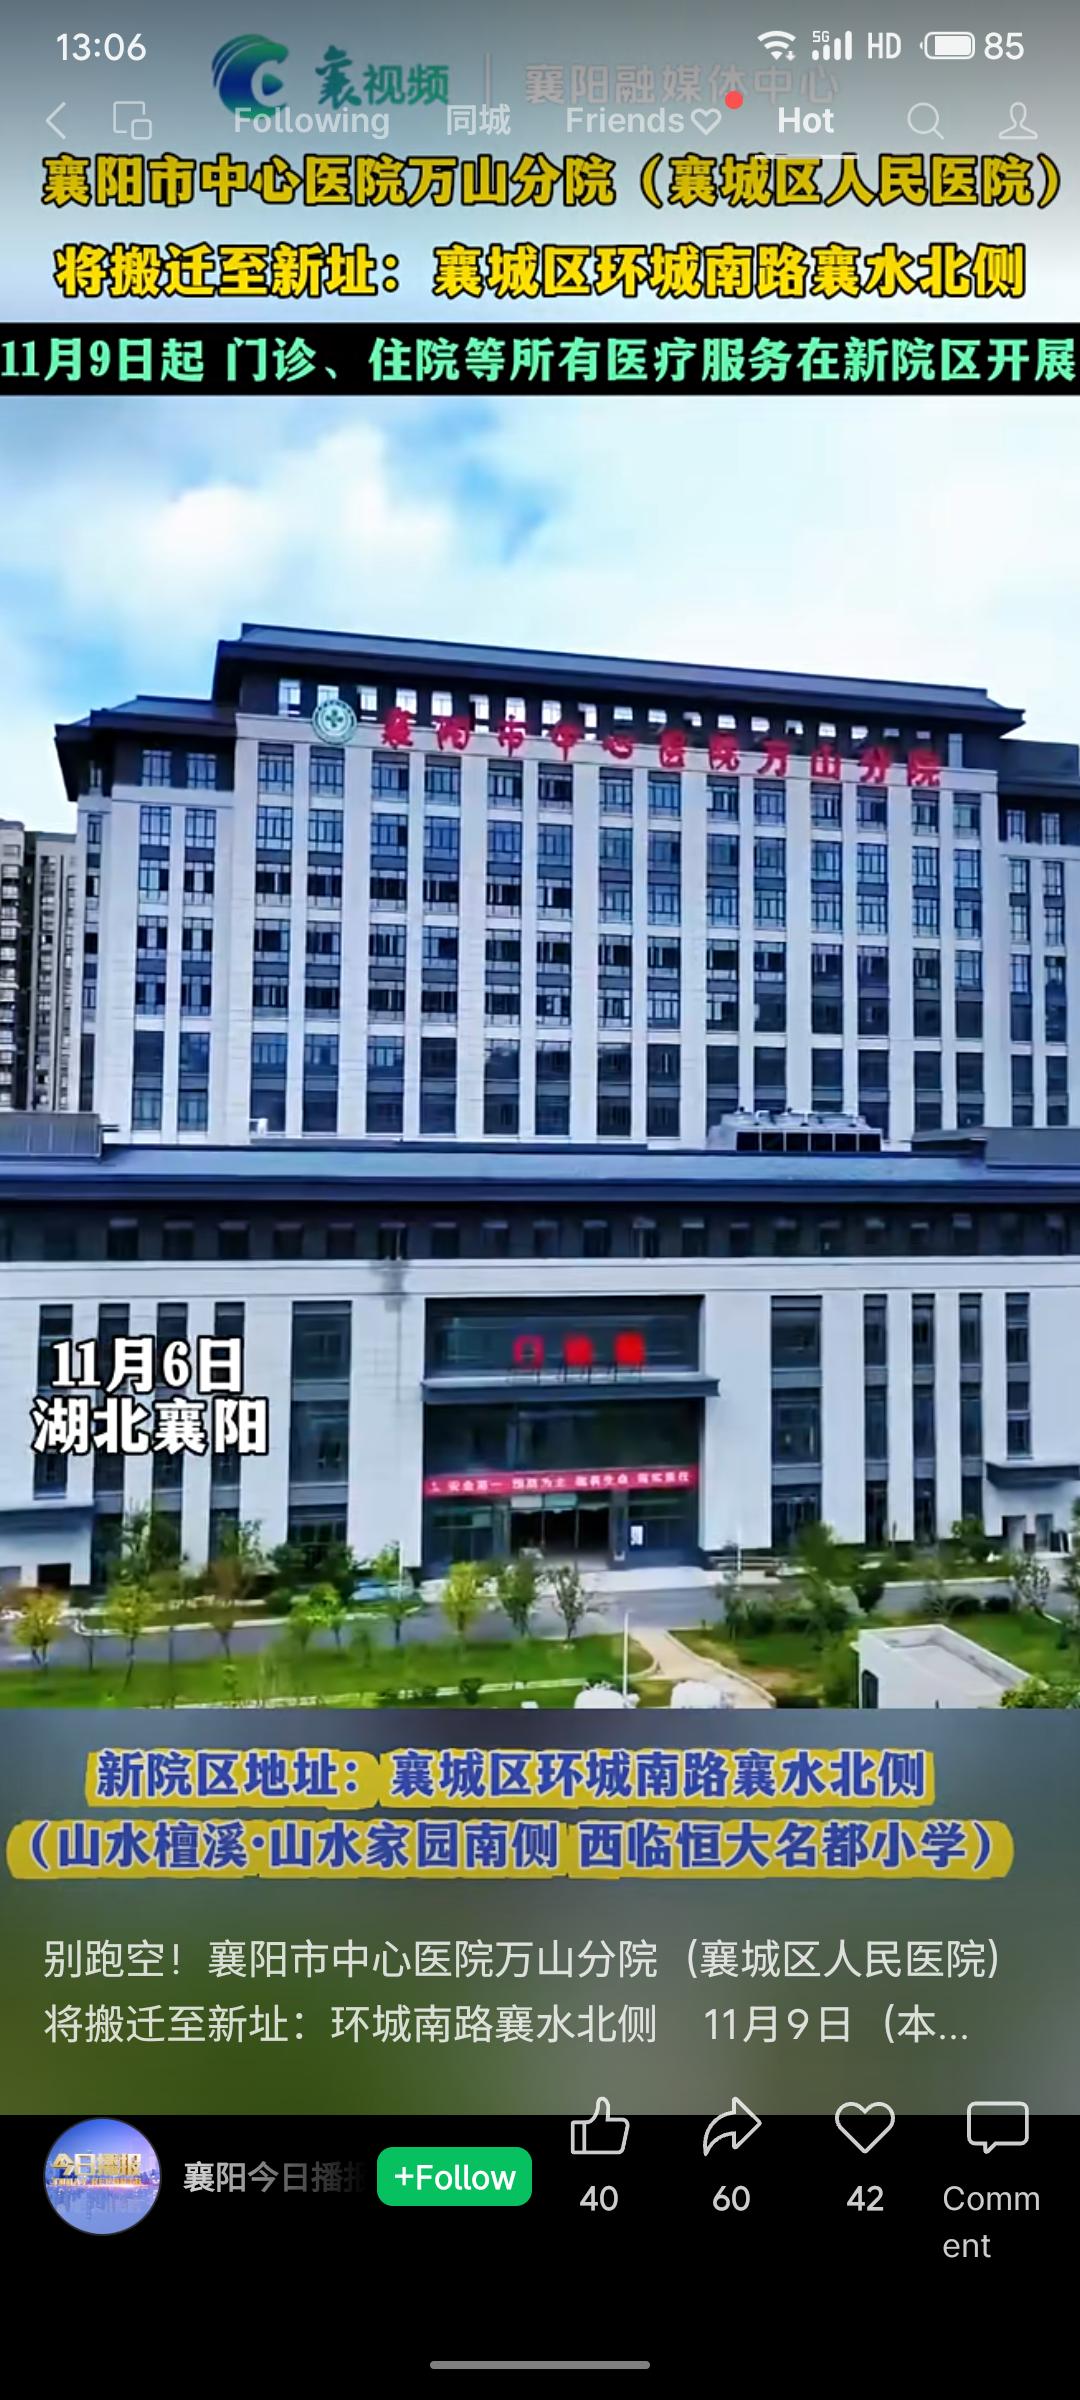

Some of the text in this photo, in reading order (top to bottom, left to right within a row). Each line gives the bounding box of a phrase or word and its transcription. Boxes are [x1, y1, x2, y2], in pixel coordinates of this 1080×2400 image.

[382, 707, 941, 786] 襄阳市中心医院万山分院
